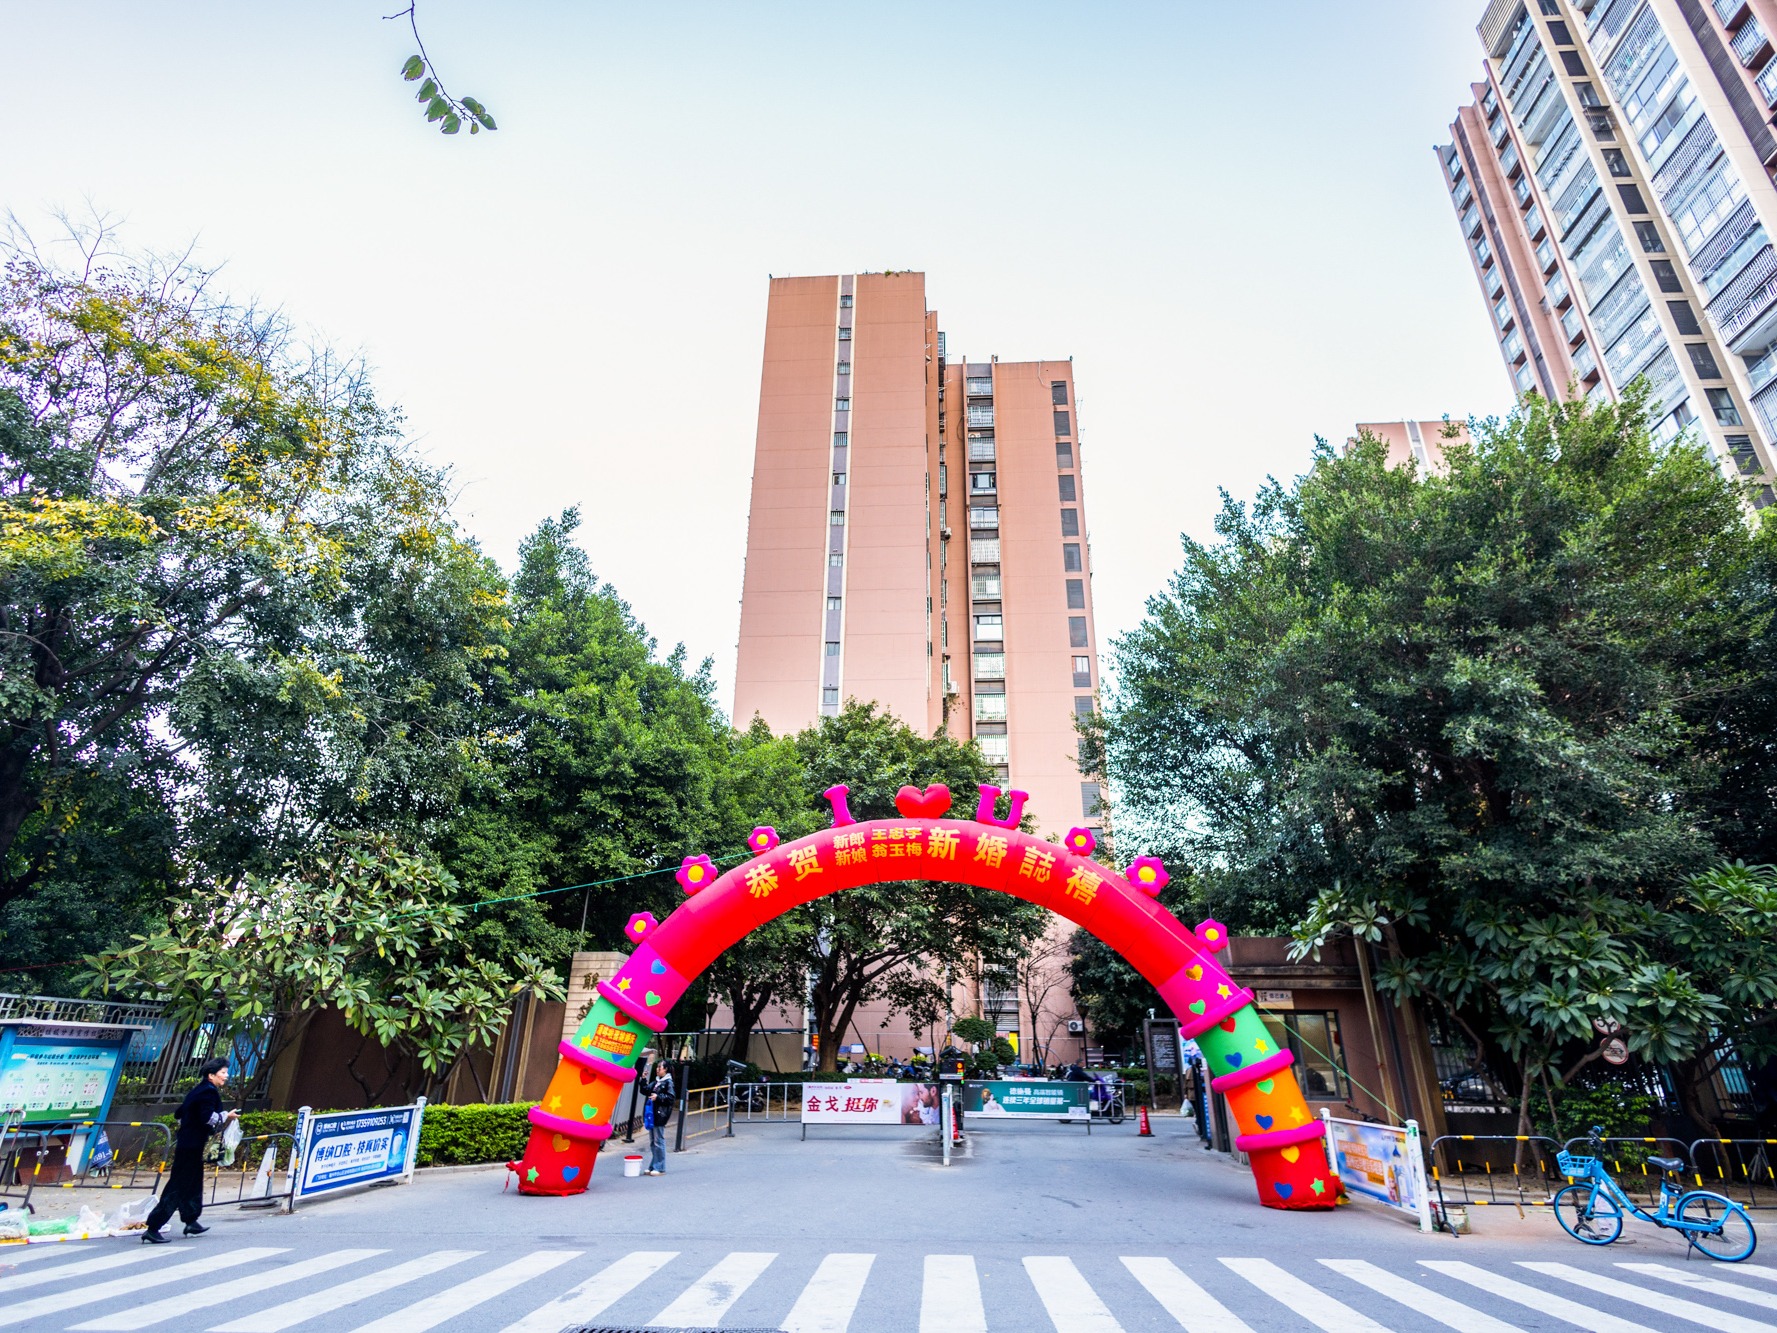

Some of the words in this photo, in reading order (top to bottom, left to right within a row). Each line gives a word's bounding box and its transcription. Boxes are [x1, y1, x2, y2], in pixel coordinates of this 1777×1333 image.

[976, 783, 1030, 831] U
[833, 832, 866, 849] 新郎
[834, 847, 868, 866] 新娘
[871, 842, 923, 858] 翁玉梅
[744, 843, 824, 900] 恭贺
